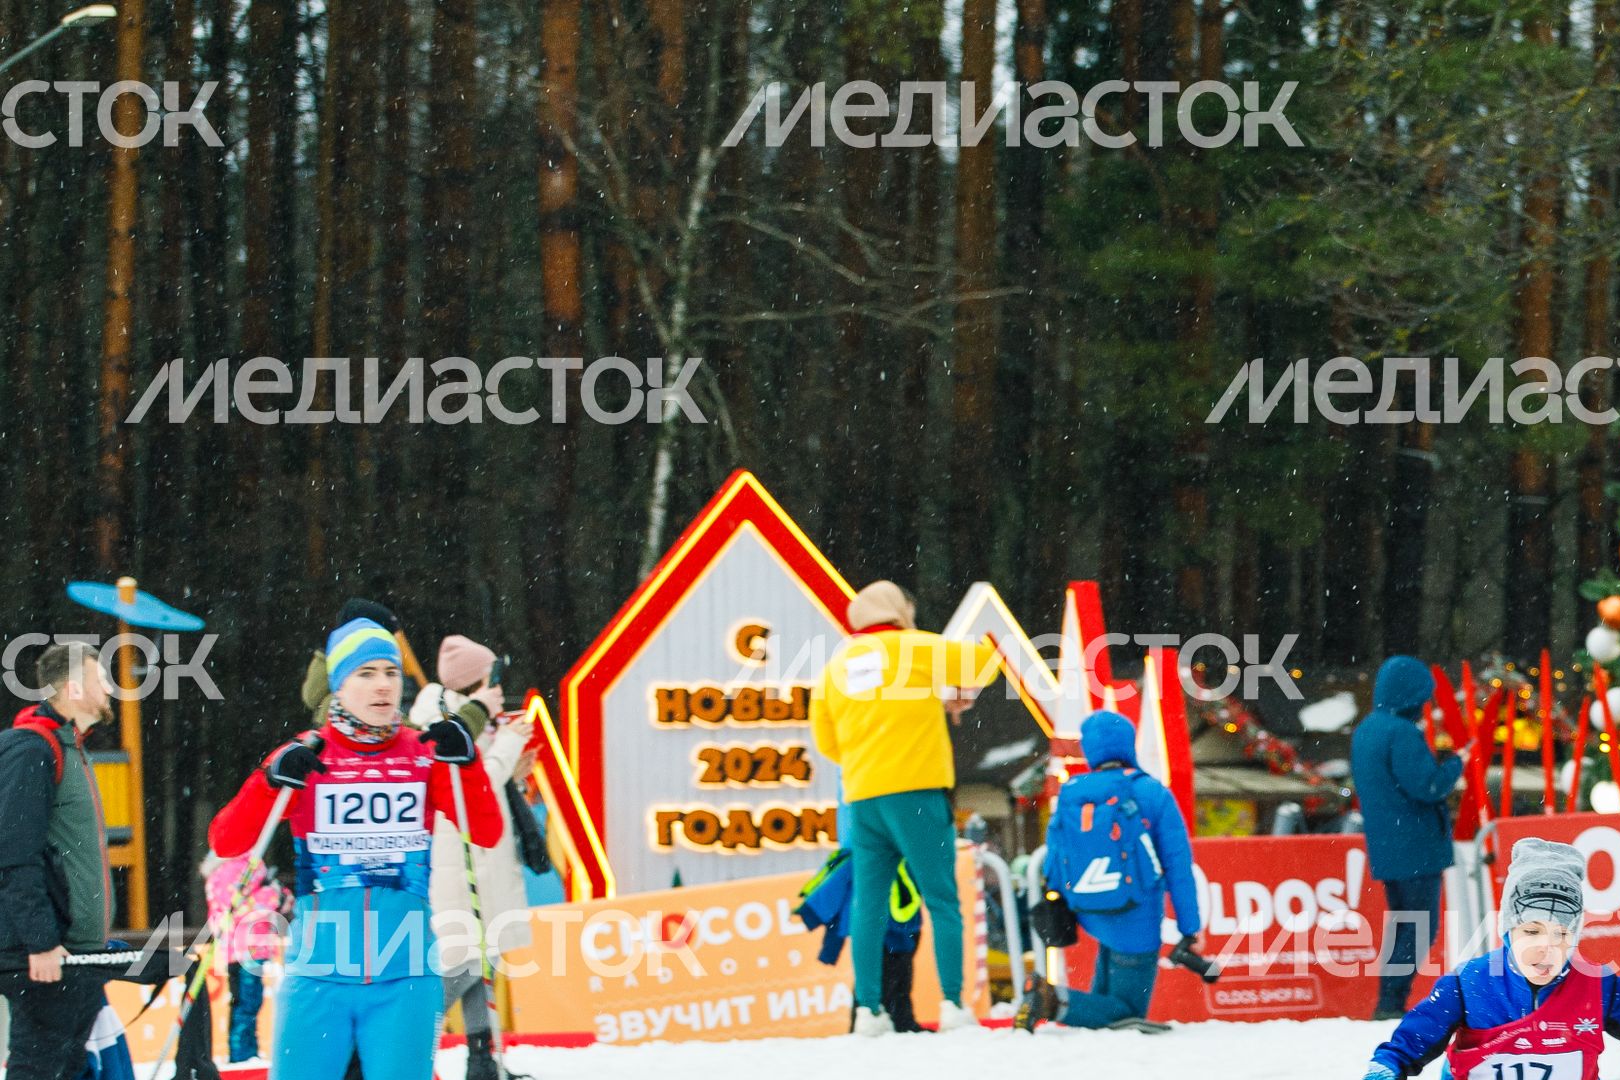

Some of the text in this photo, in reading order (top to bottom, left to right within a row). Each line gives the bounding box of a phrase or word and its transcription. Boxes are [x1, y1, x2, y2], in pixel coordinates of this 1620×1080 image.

[698, 747, 811, 784] 2024
[323, 791, 418, 825] 1202
[656, 808, 839, 848] ГОДОМ
[66, 950, 145, 965] NORDWAY
[594, 994, 756, 1043] ЗВУЧИТ
